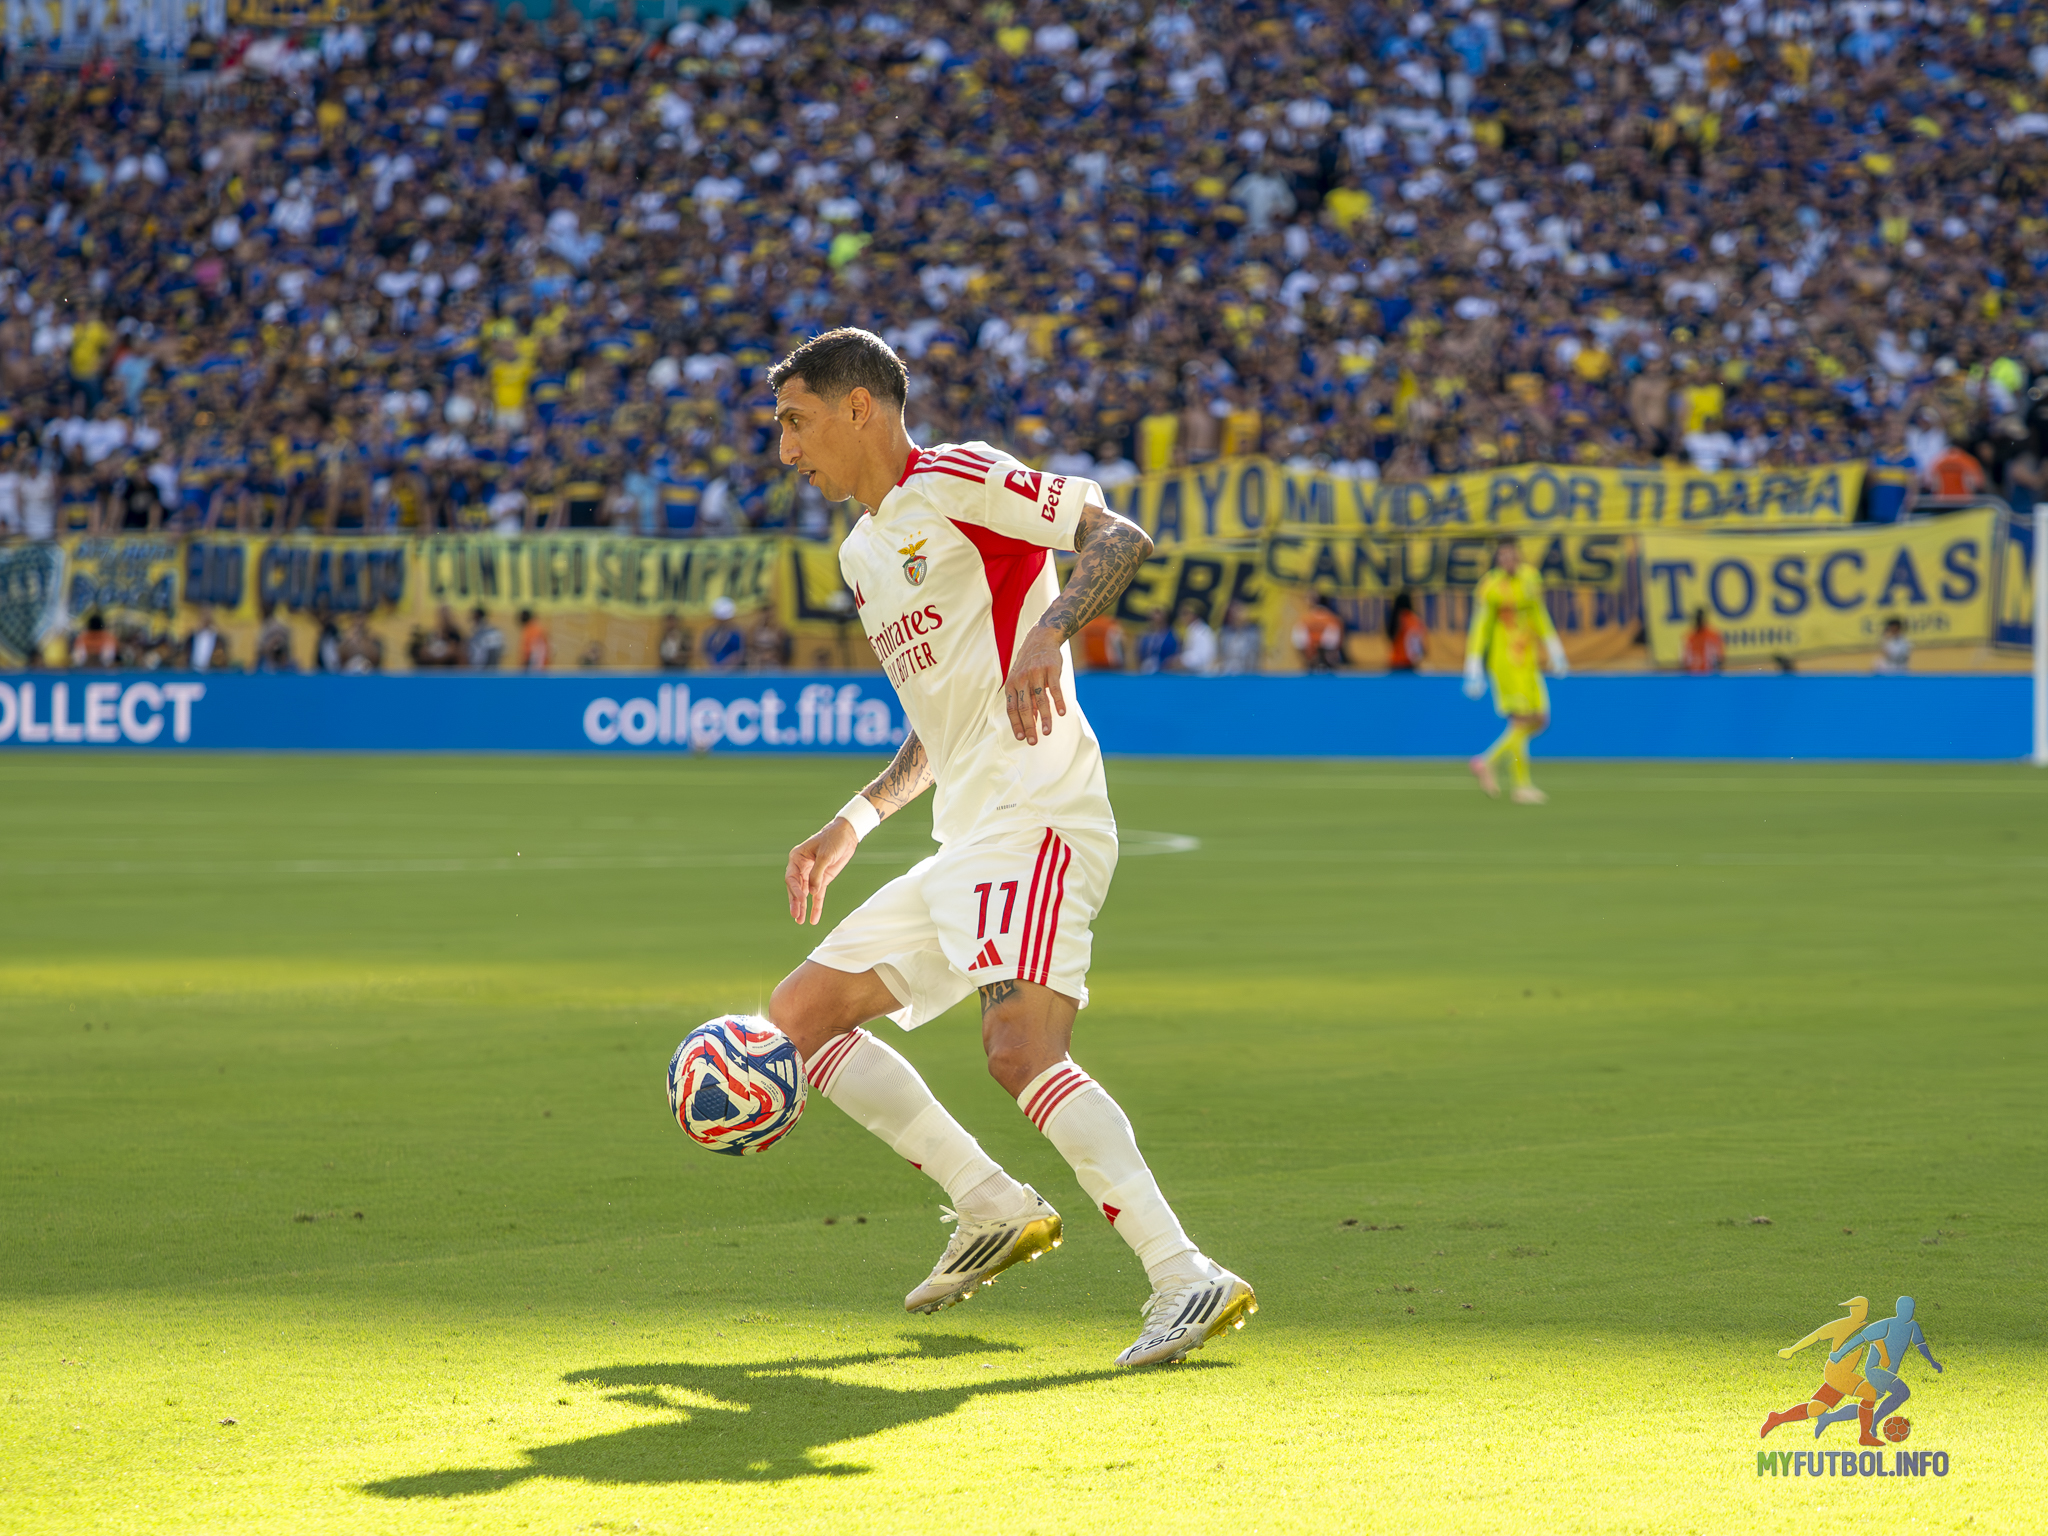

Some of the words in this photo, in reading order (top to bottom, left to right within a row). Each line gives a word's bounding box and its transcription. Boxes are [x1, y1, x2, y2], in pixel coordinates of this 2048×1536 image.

[1041, 476, 1067, 523] Beta
[1650, 539, 1983, 624] TOSCAS
[973, 880, 1019, 940] 11
